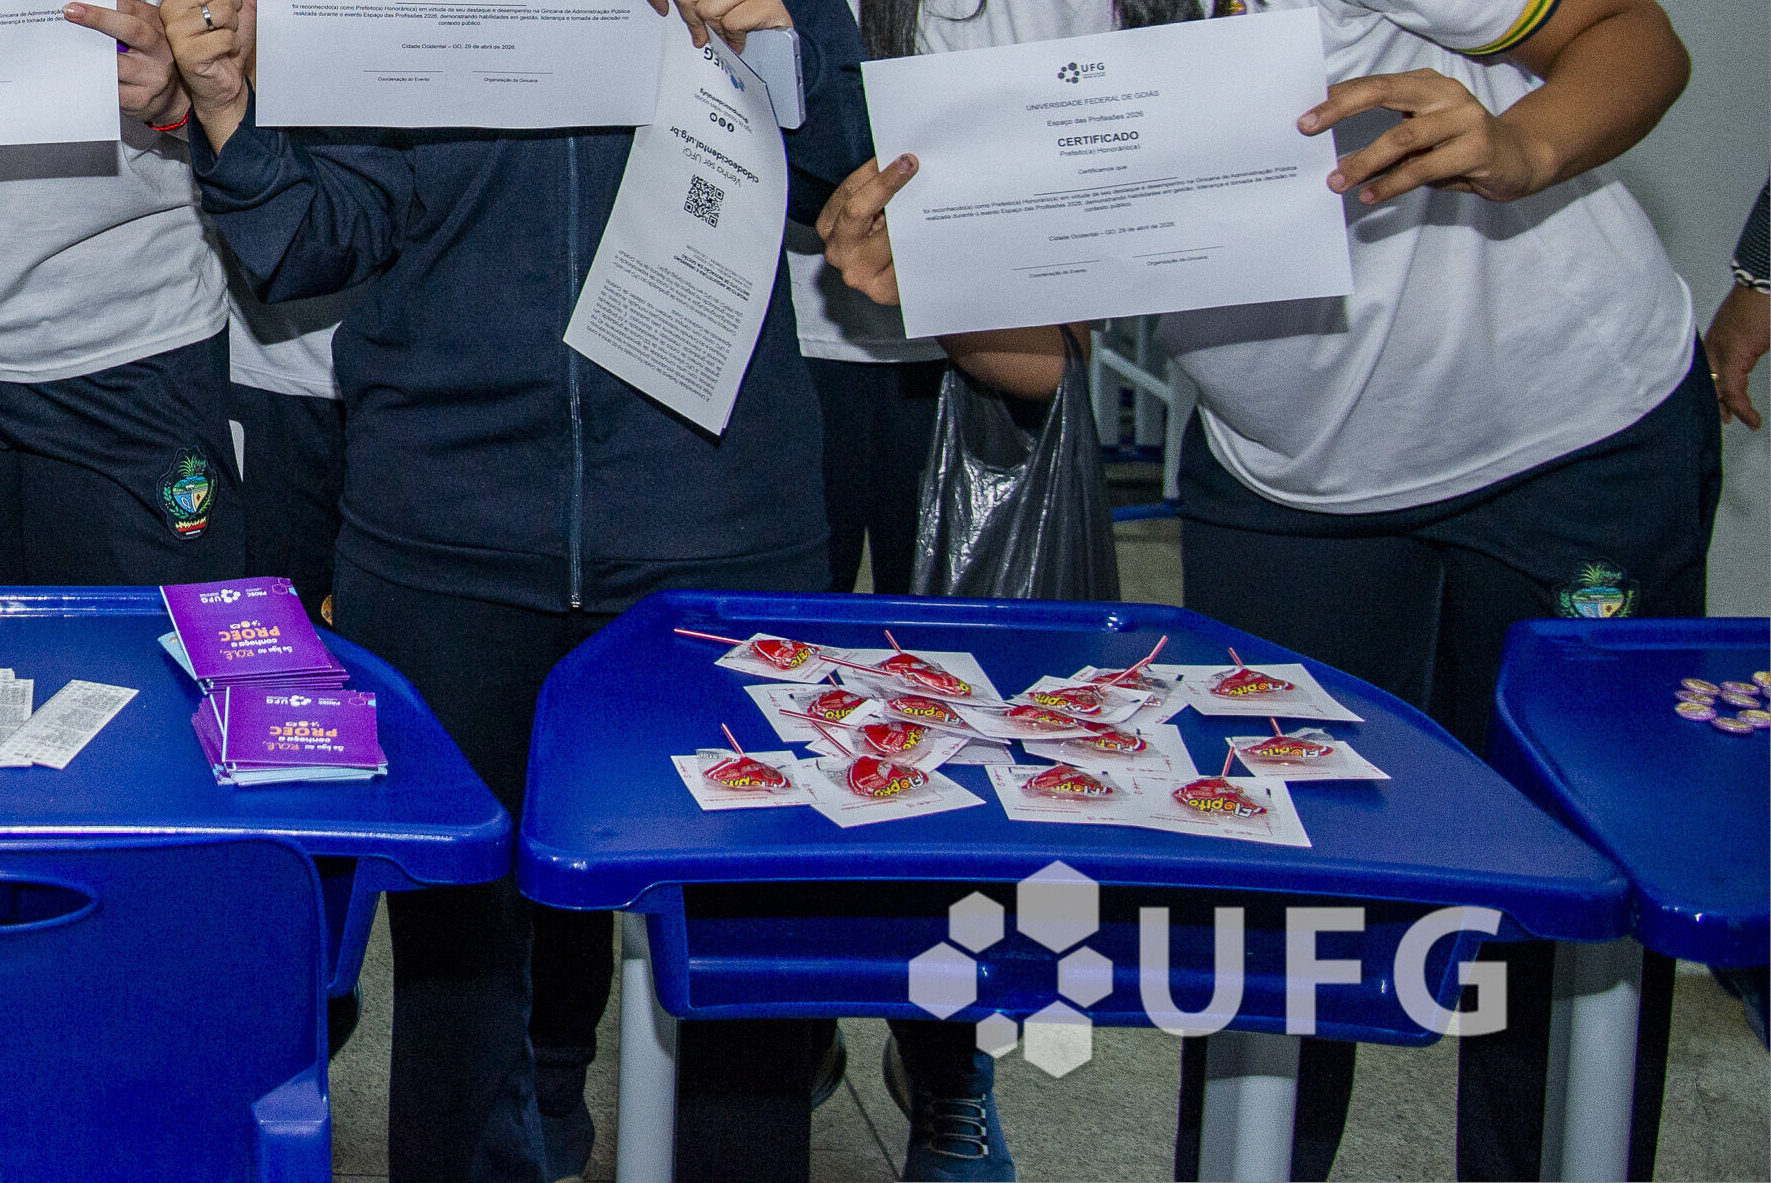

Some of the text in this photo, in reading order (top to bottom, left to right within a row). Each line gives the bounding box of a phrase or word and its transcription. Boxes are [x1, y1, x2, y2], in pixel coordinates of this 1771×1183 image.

[1081, 62, 1104, 72] UFG
[1026, 100, 1083, 111] UNIVERSIDADE
[1084, 96, 1120, 105] FEDERAL
[1121, 93, 1131, 101] DE
[1057, 131, 1139, 147] CERTIFICADO
[669, 125, 760, 184] cidadeocidental.ufg.br
[703, 159, 716, 170] ser
[716, 165, 742, 188] Venha
[218, 625, 280, 642] PROEC
[239, 638, 277, 647] conheça
[269, 726, 337, 737] PROEC
[1188, 797, 1254, 818] Flopito
